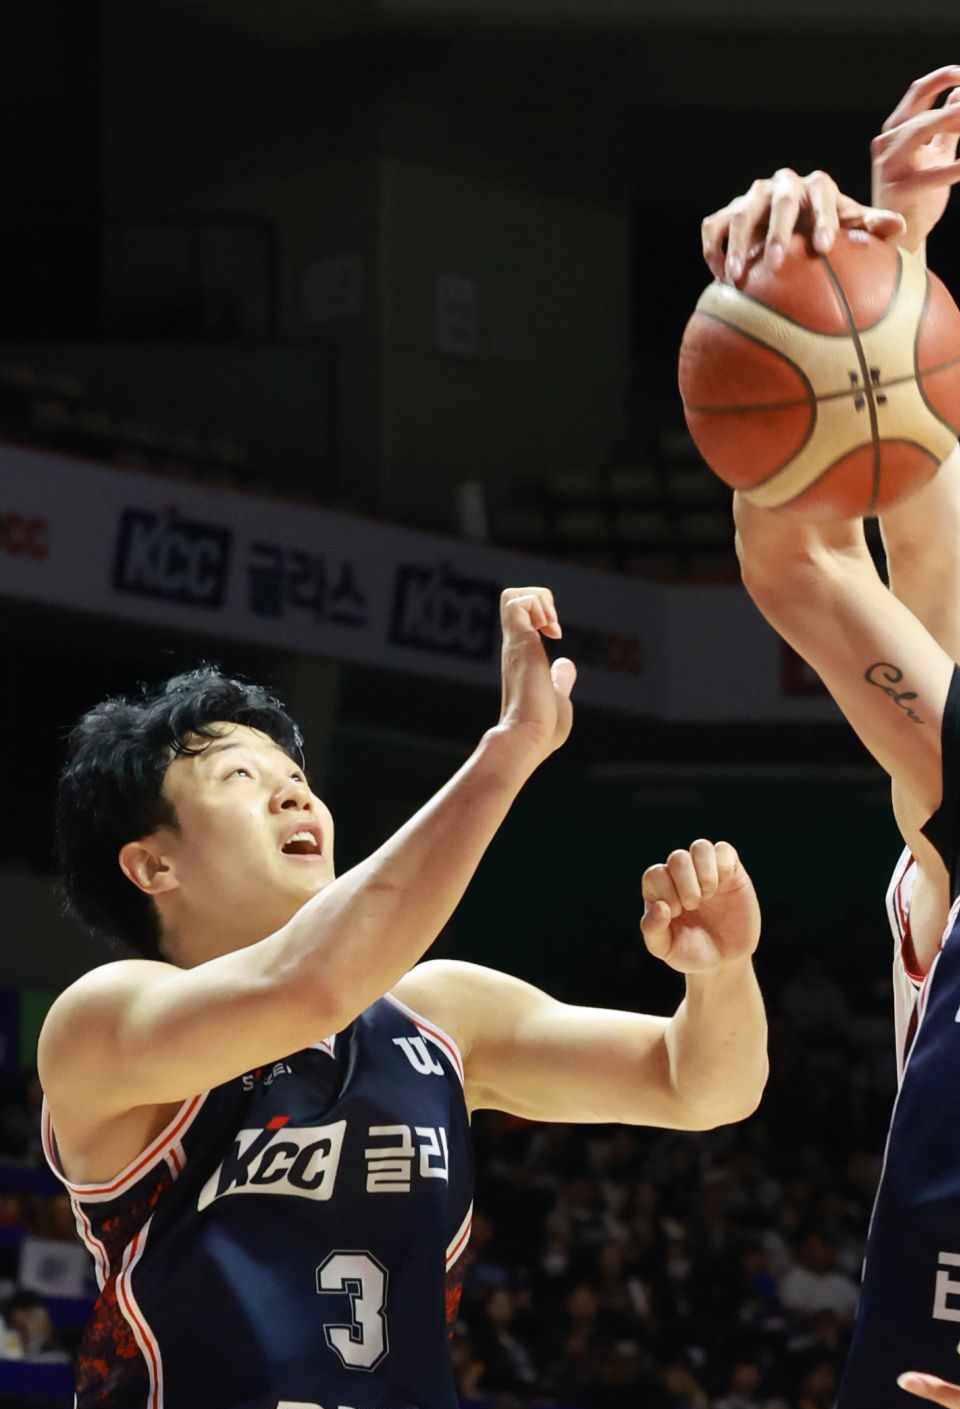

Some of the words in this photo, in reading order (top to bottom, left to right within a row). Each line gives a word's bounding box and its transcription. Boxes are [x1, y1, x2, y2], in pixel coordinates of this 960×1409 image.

[122, 507, 224, 599] KCC
[246, 543, 366, 628] 글라스
[399, 568, 496, 656] KCC
[215, 1116, 332, 1197] KCC
[315, 1250, 389, 1372] 3
